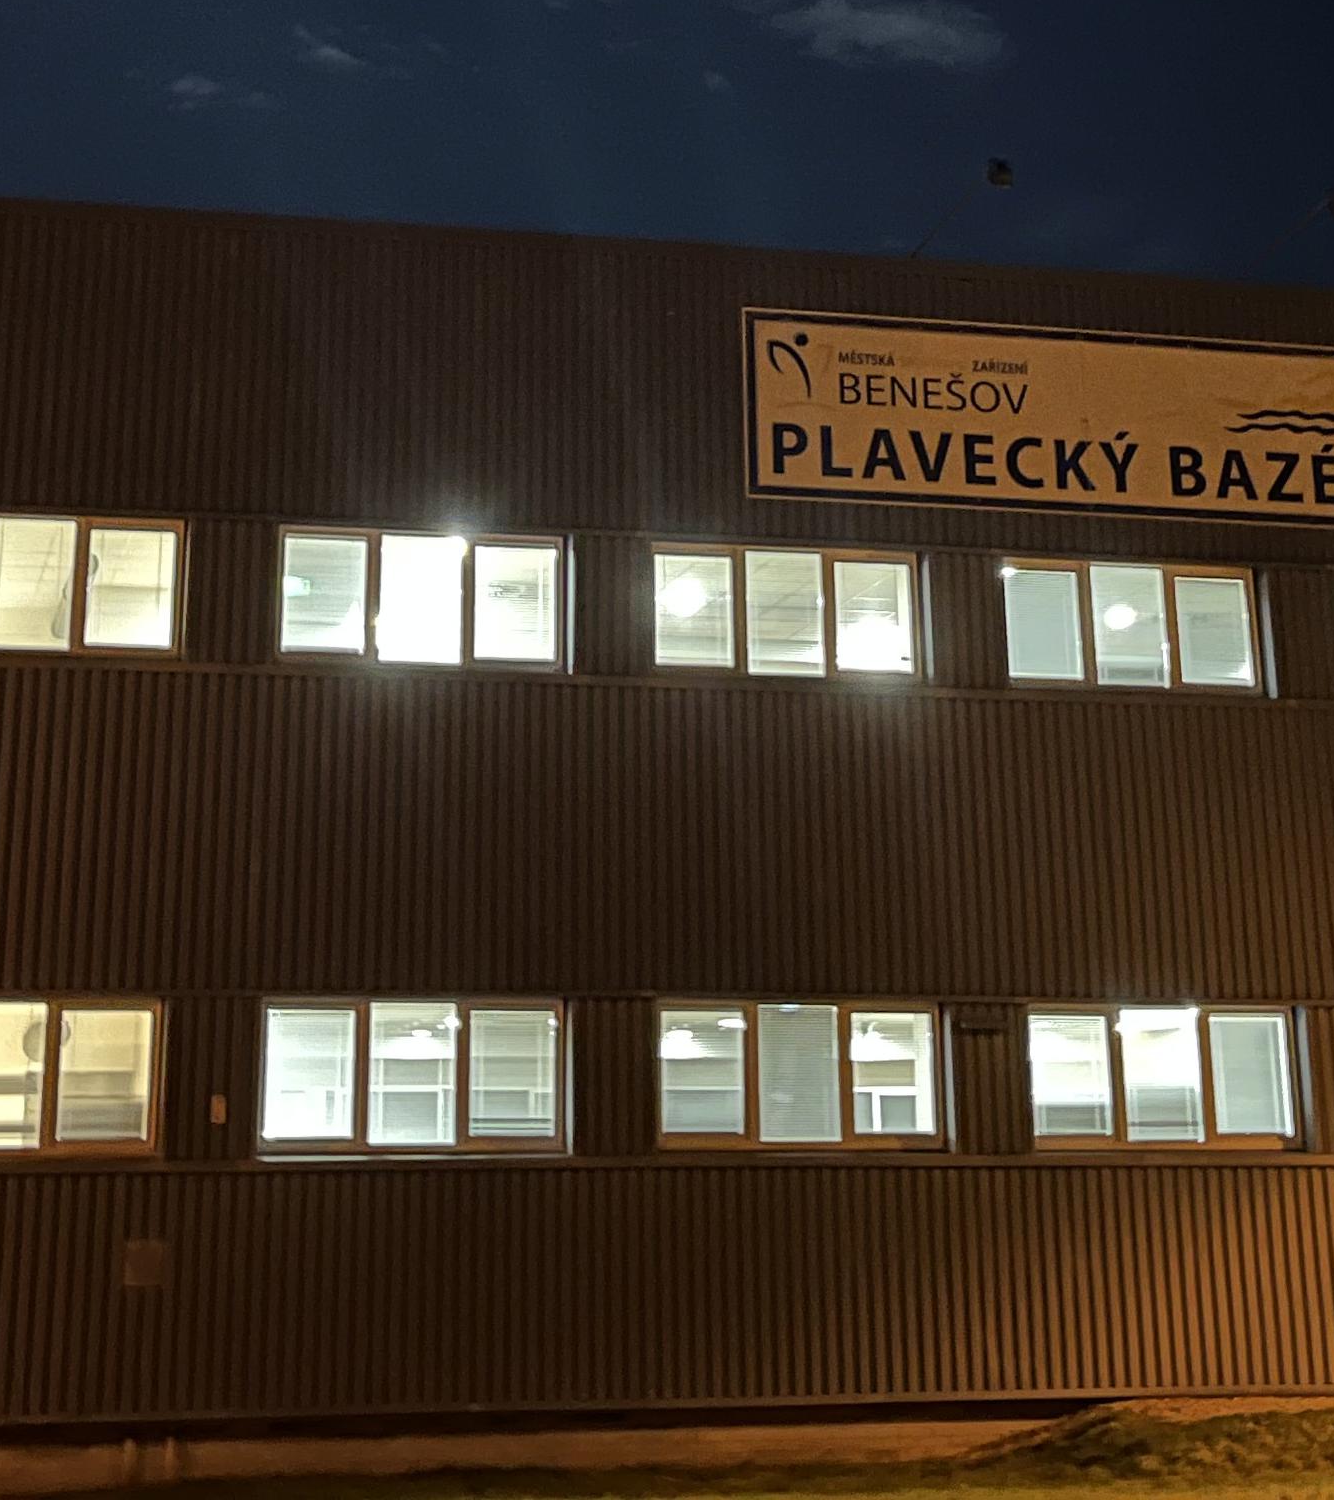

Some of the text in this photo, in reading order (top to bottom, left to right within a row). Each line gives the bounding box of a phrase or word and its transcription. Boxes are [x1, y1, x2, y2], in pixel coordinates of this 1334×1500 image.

[838, 350, 895, 367] MĚSTSKÁ
[838, 372, 1029, 415] BENEŠOV
[771, 421, 1139, 493] PLAVECKÝ
